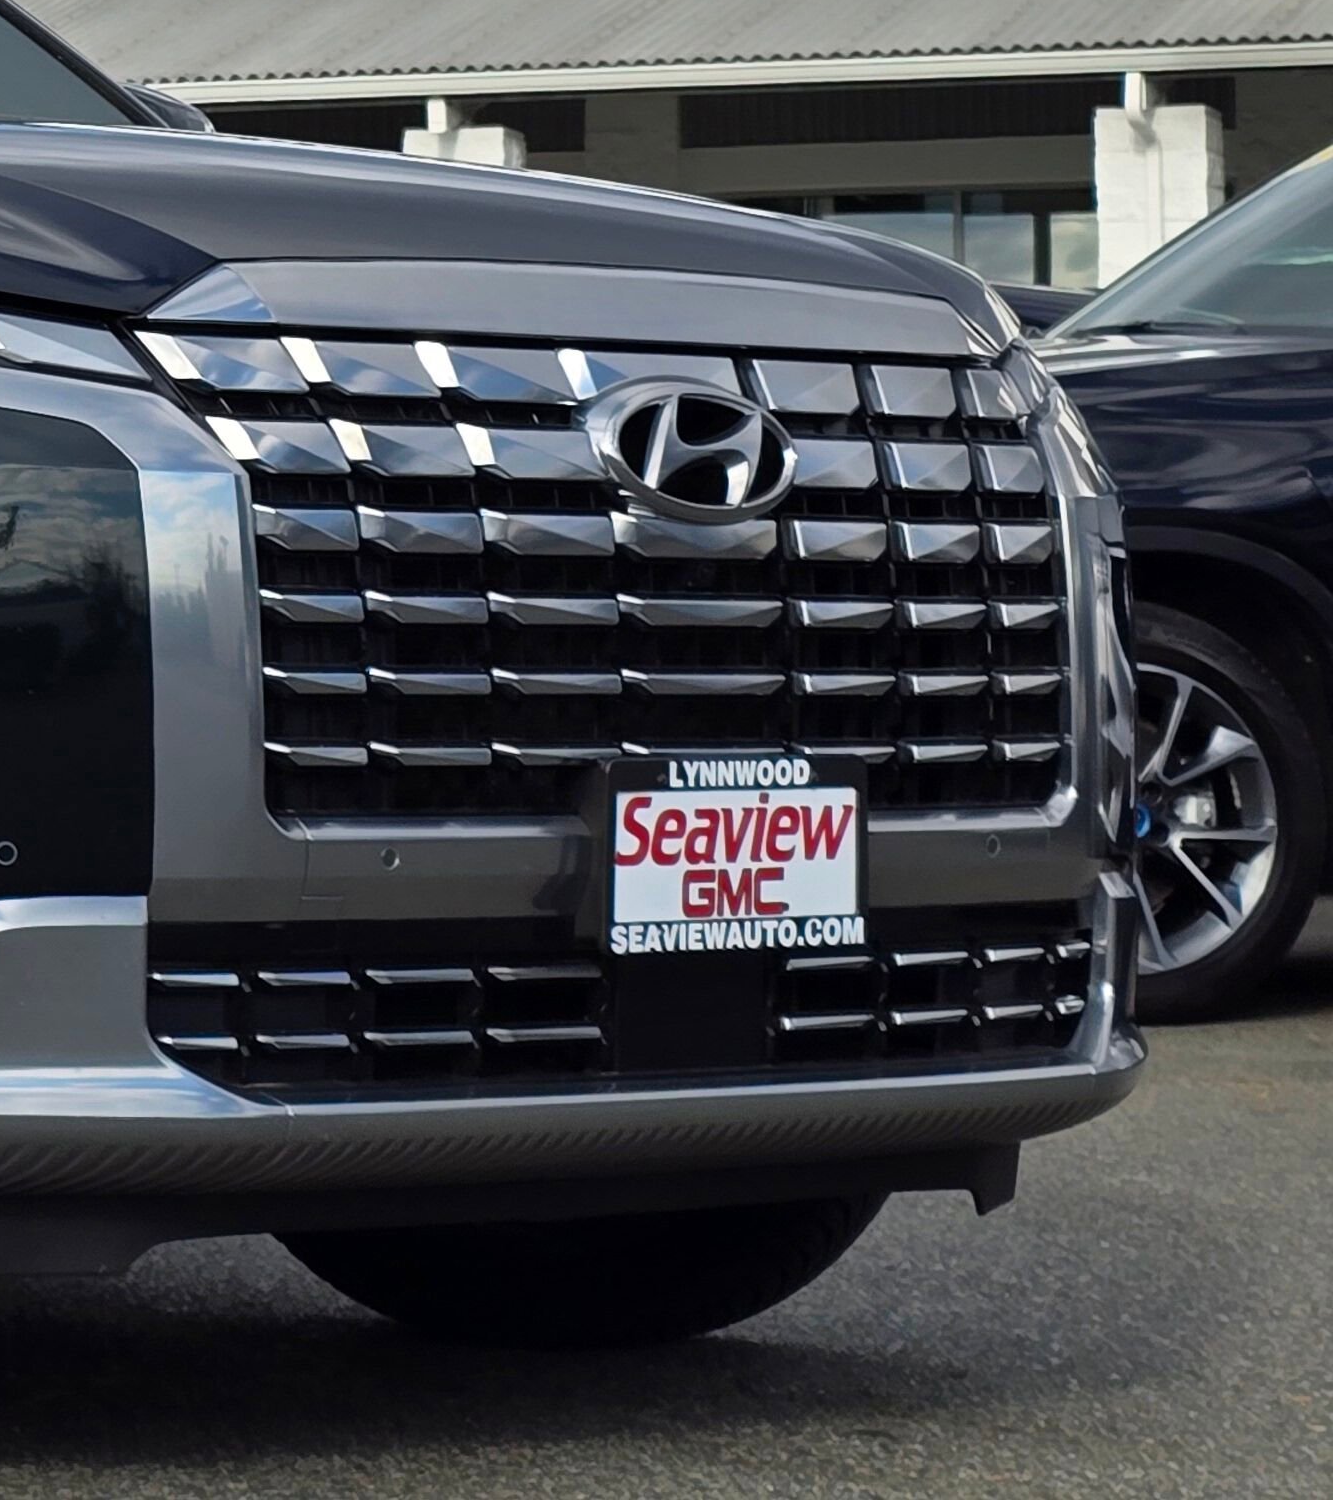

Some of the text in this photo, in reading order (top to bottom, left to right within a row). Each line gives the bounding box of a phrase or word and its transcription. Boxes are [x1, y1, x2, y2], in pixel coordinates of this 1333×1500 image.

[668, 758, 811, 788] LYNNWOOD
[613, 791, 854, 866] Seaview
[681, 866, 790, 918] GMC
[610, 916, 865, 955] SEAVIEWAUTO.COM
